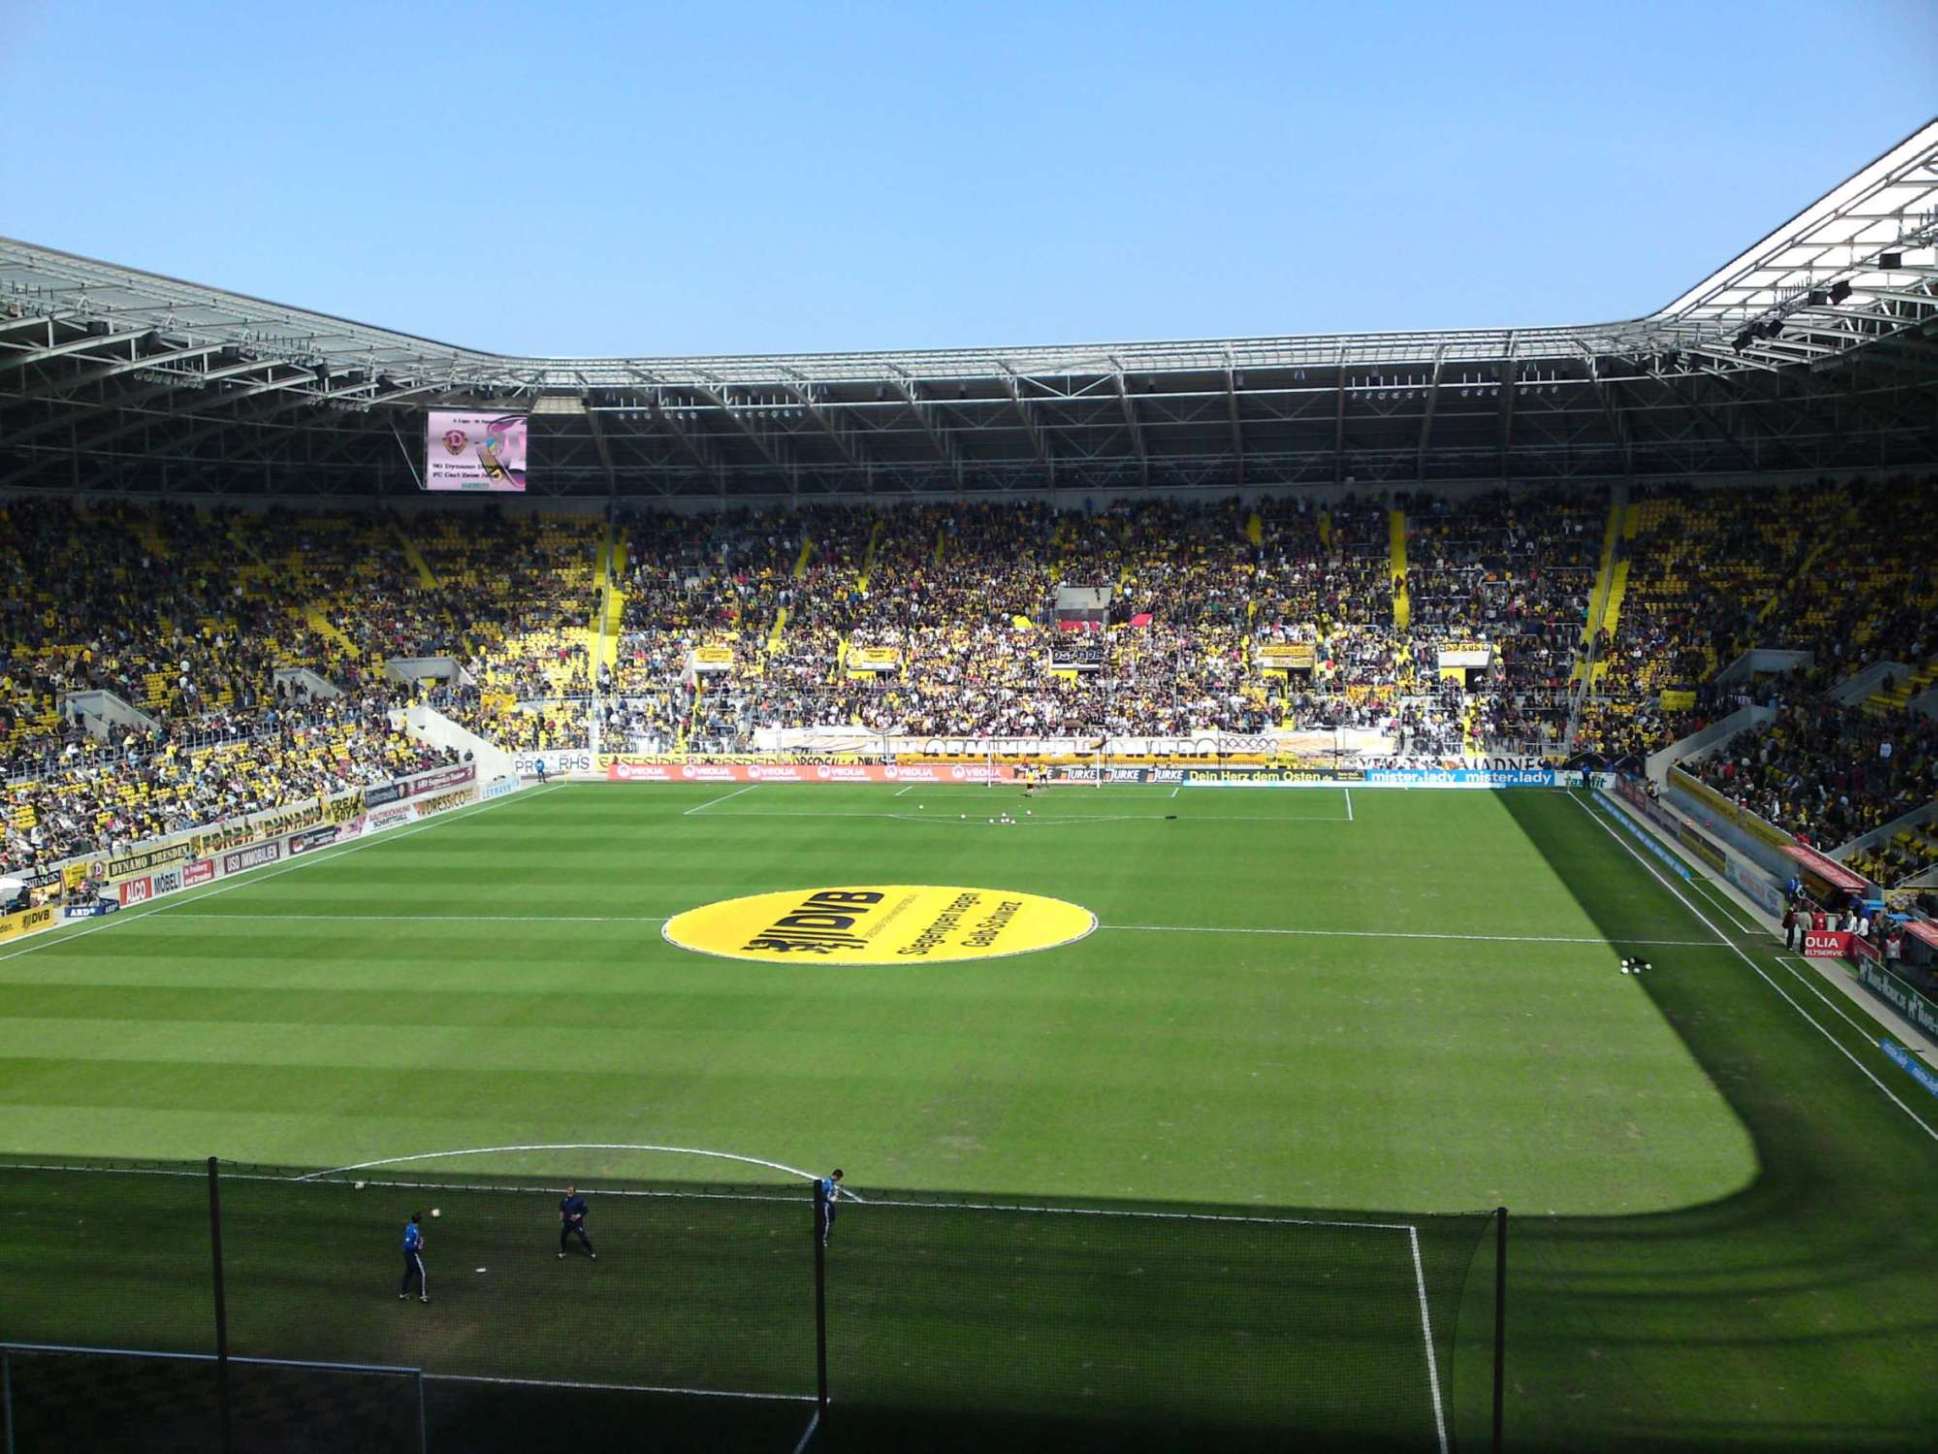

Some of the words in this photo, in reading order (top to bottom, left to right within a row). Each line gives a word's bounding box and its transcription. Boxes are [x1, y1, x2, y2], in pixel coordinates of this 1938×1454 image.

[558, 756, 590, 771] RHS
[1189, 769, 1217, 782] Dein
[1220, 769, 1249, 782] Herz
[1252, 770, 1279, 782] dem
[1371, 771, 1457, 785] mister.lady
[1465, 771, 1552, 785] mister.lady
[31, 909, 51, 924] DVB
[773, 891, 886, 930] DVB
[1805, 936, 1839, 949] OLIA
